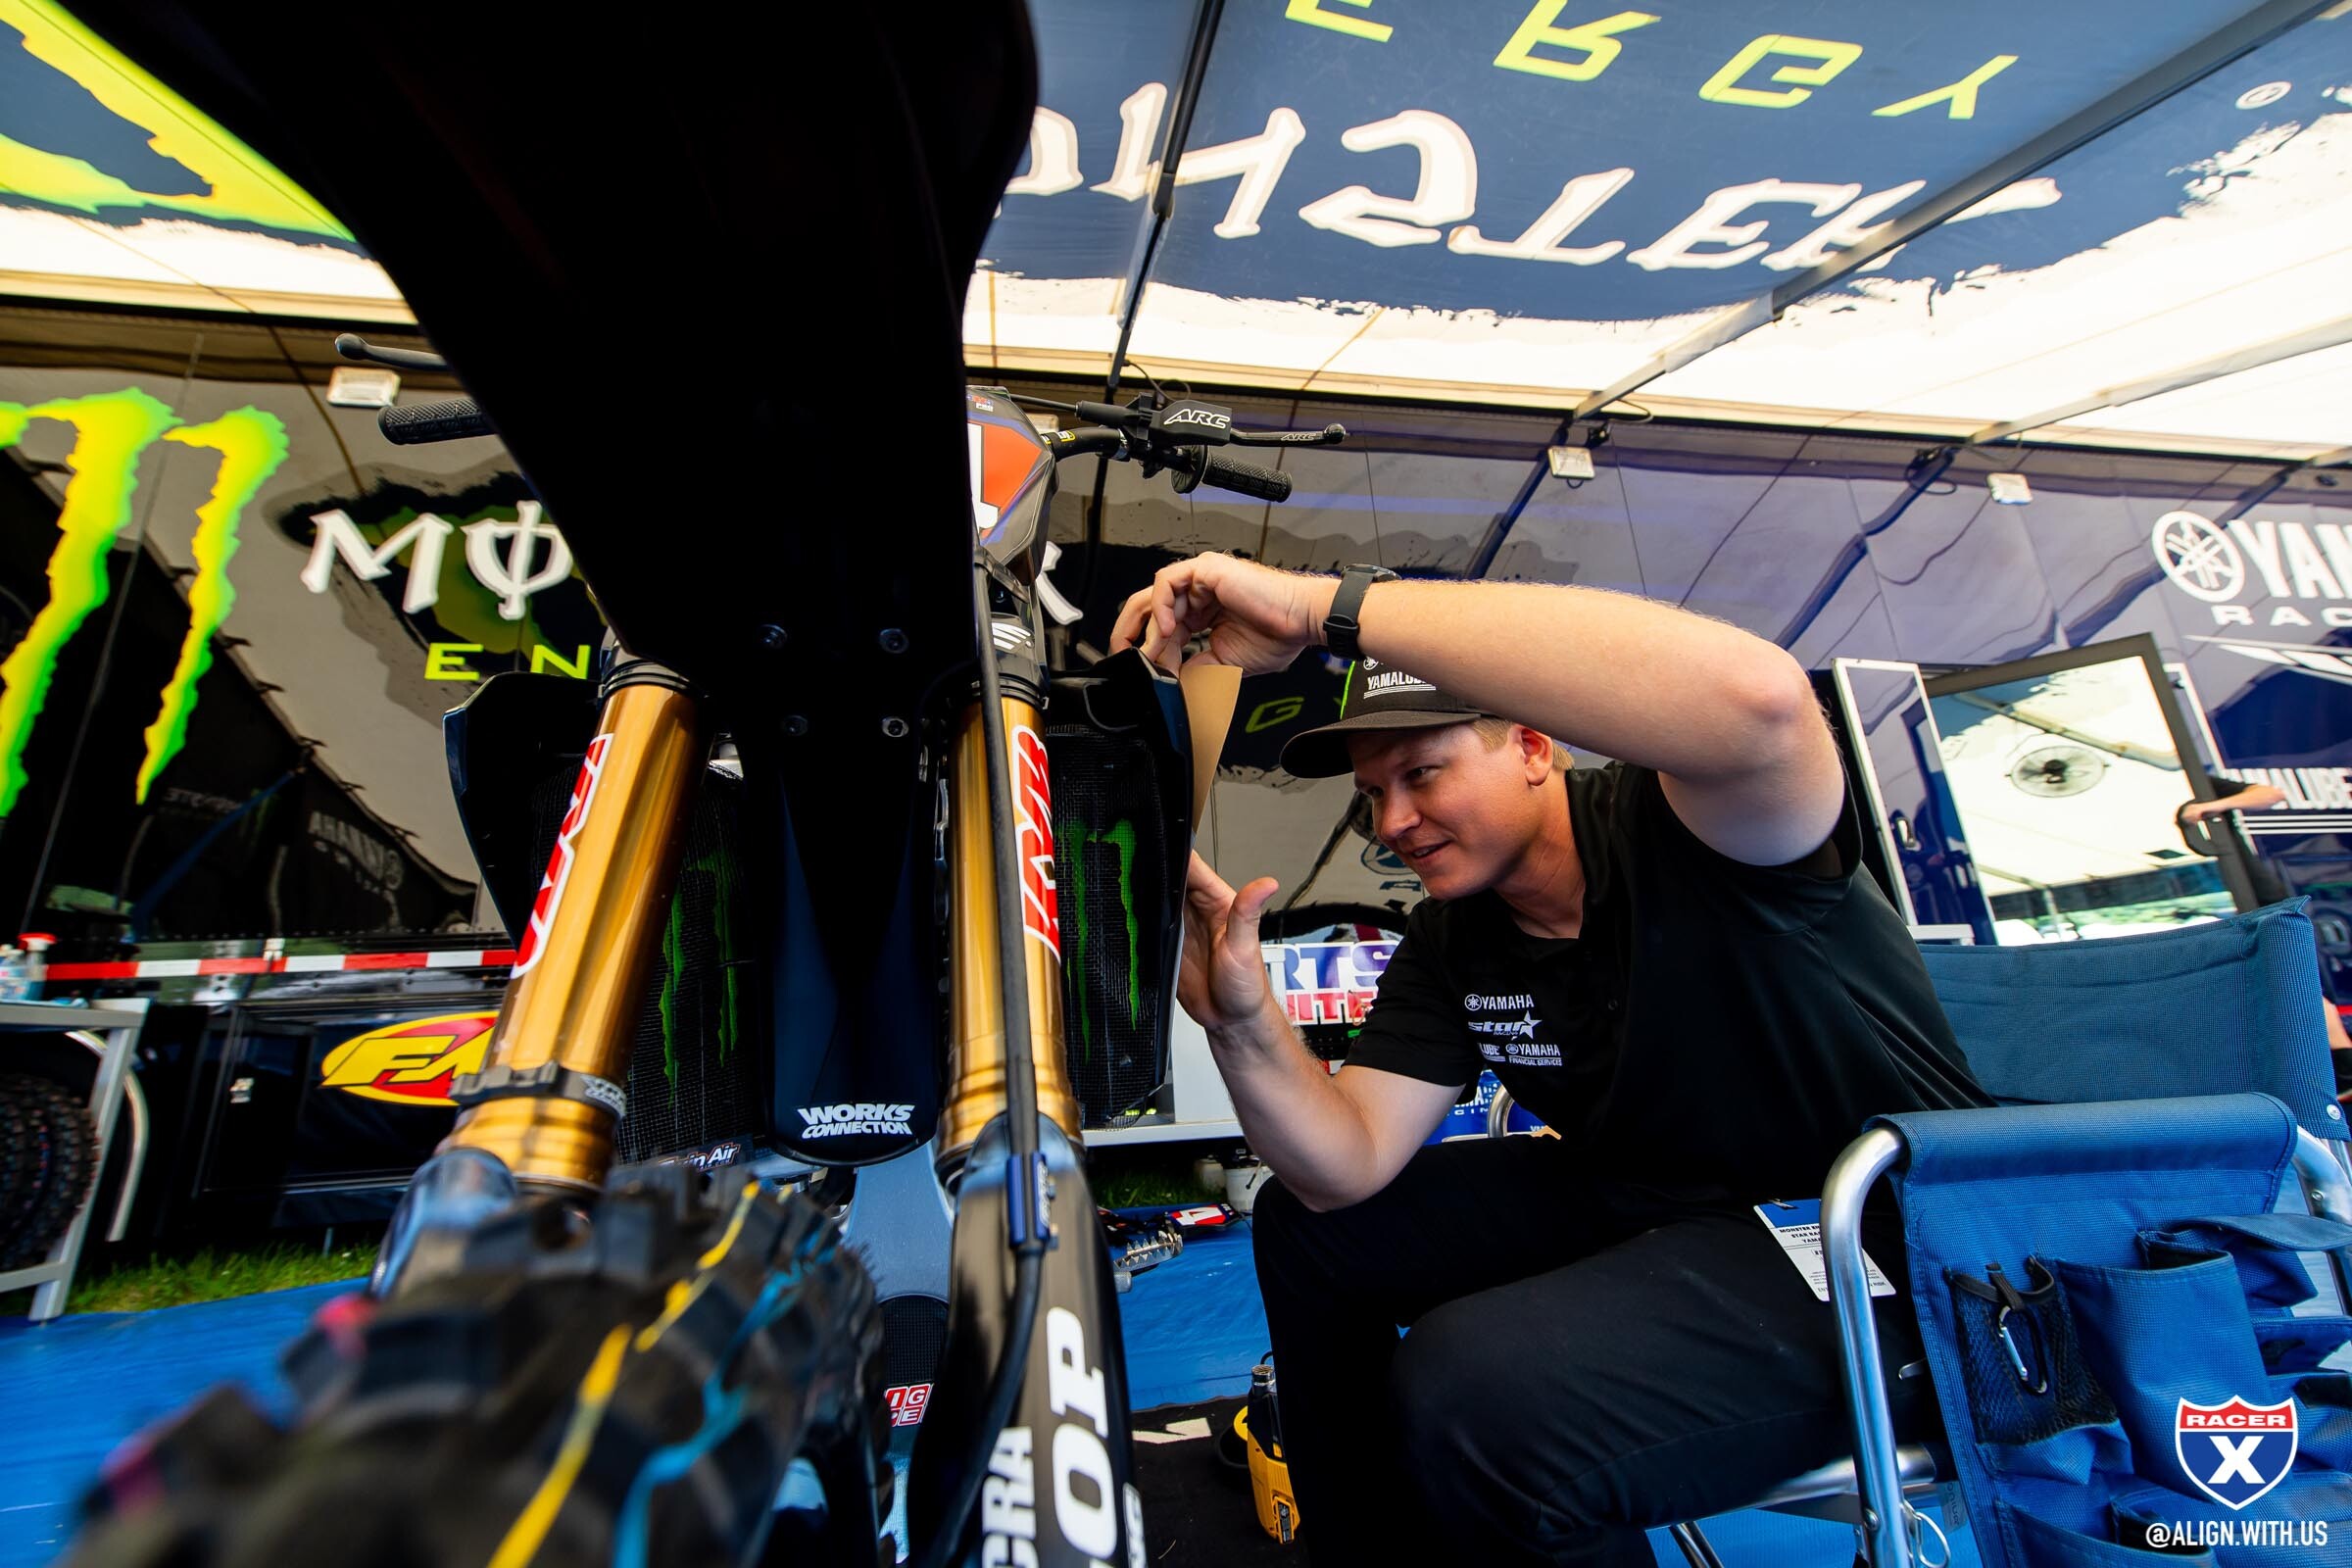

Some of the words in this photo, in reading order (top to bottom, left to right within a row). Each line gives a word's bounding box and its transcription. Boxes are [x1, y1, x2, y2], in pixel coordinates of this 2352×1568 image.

[1163, 409, 1231, 430] ARC
[1367, 671, 1428, 690] YAMALU
[1481, 993, 1535, 1010] YAMAHA
[1518, 1044, 1561, 1056] YAMAHA
[1509, 1057, 1537, 1066] FINANCIAL
[798, 1103, 915, 1125] WORKS
[802, 1121, 912, 1140] CONNECTION
[707, 1145, 738, 1164] Air
[1045, 1307, 1118, 1568] OP
